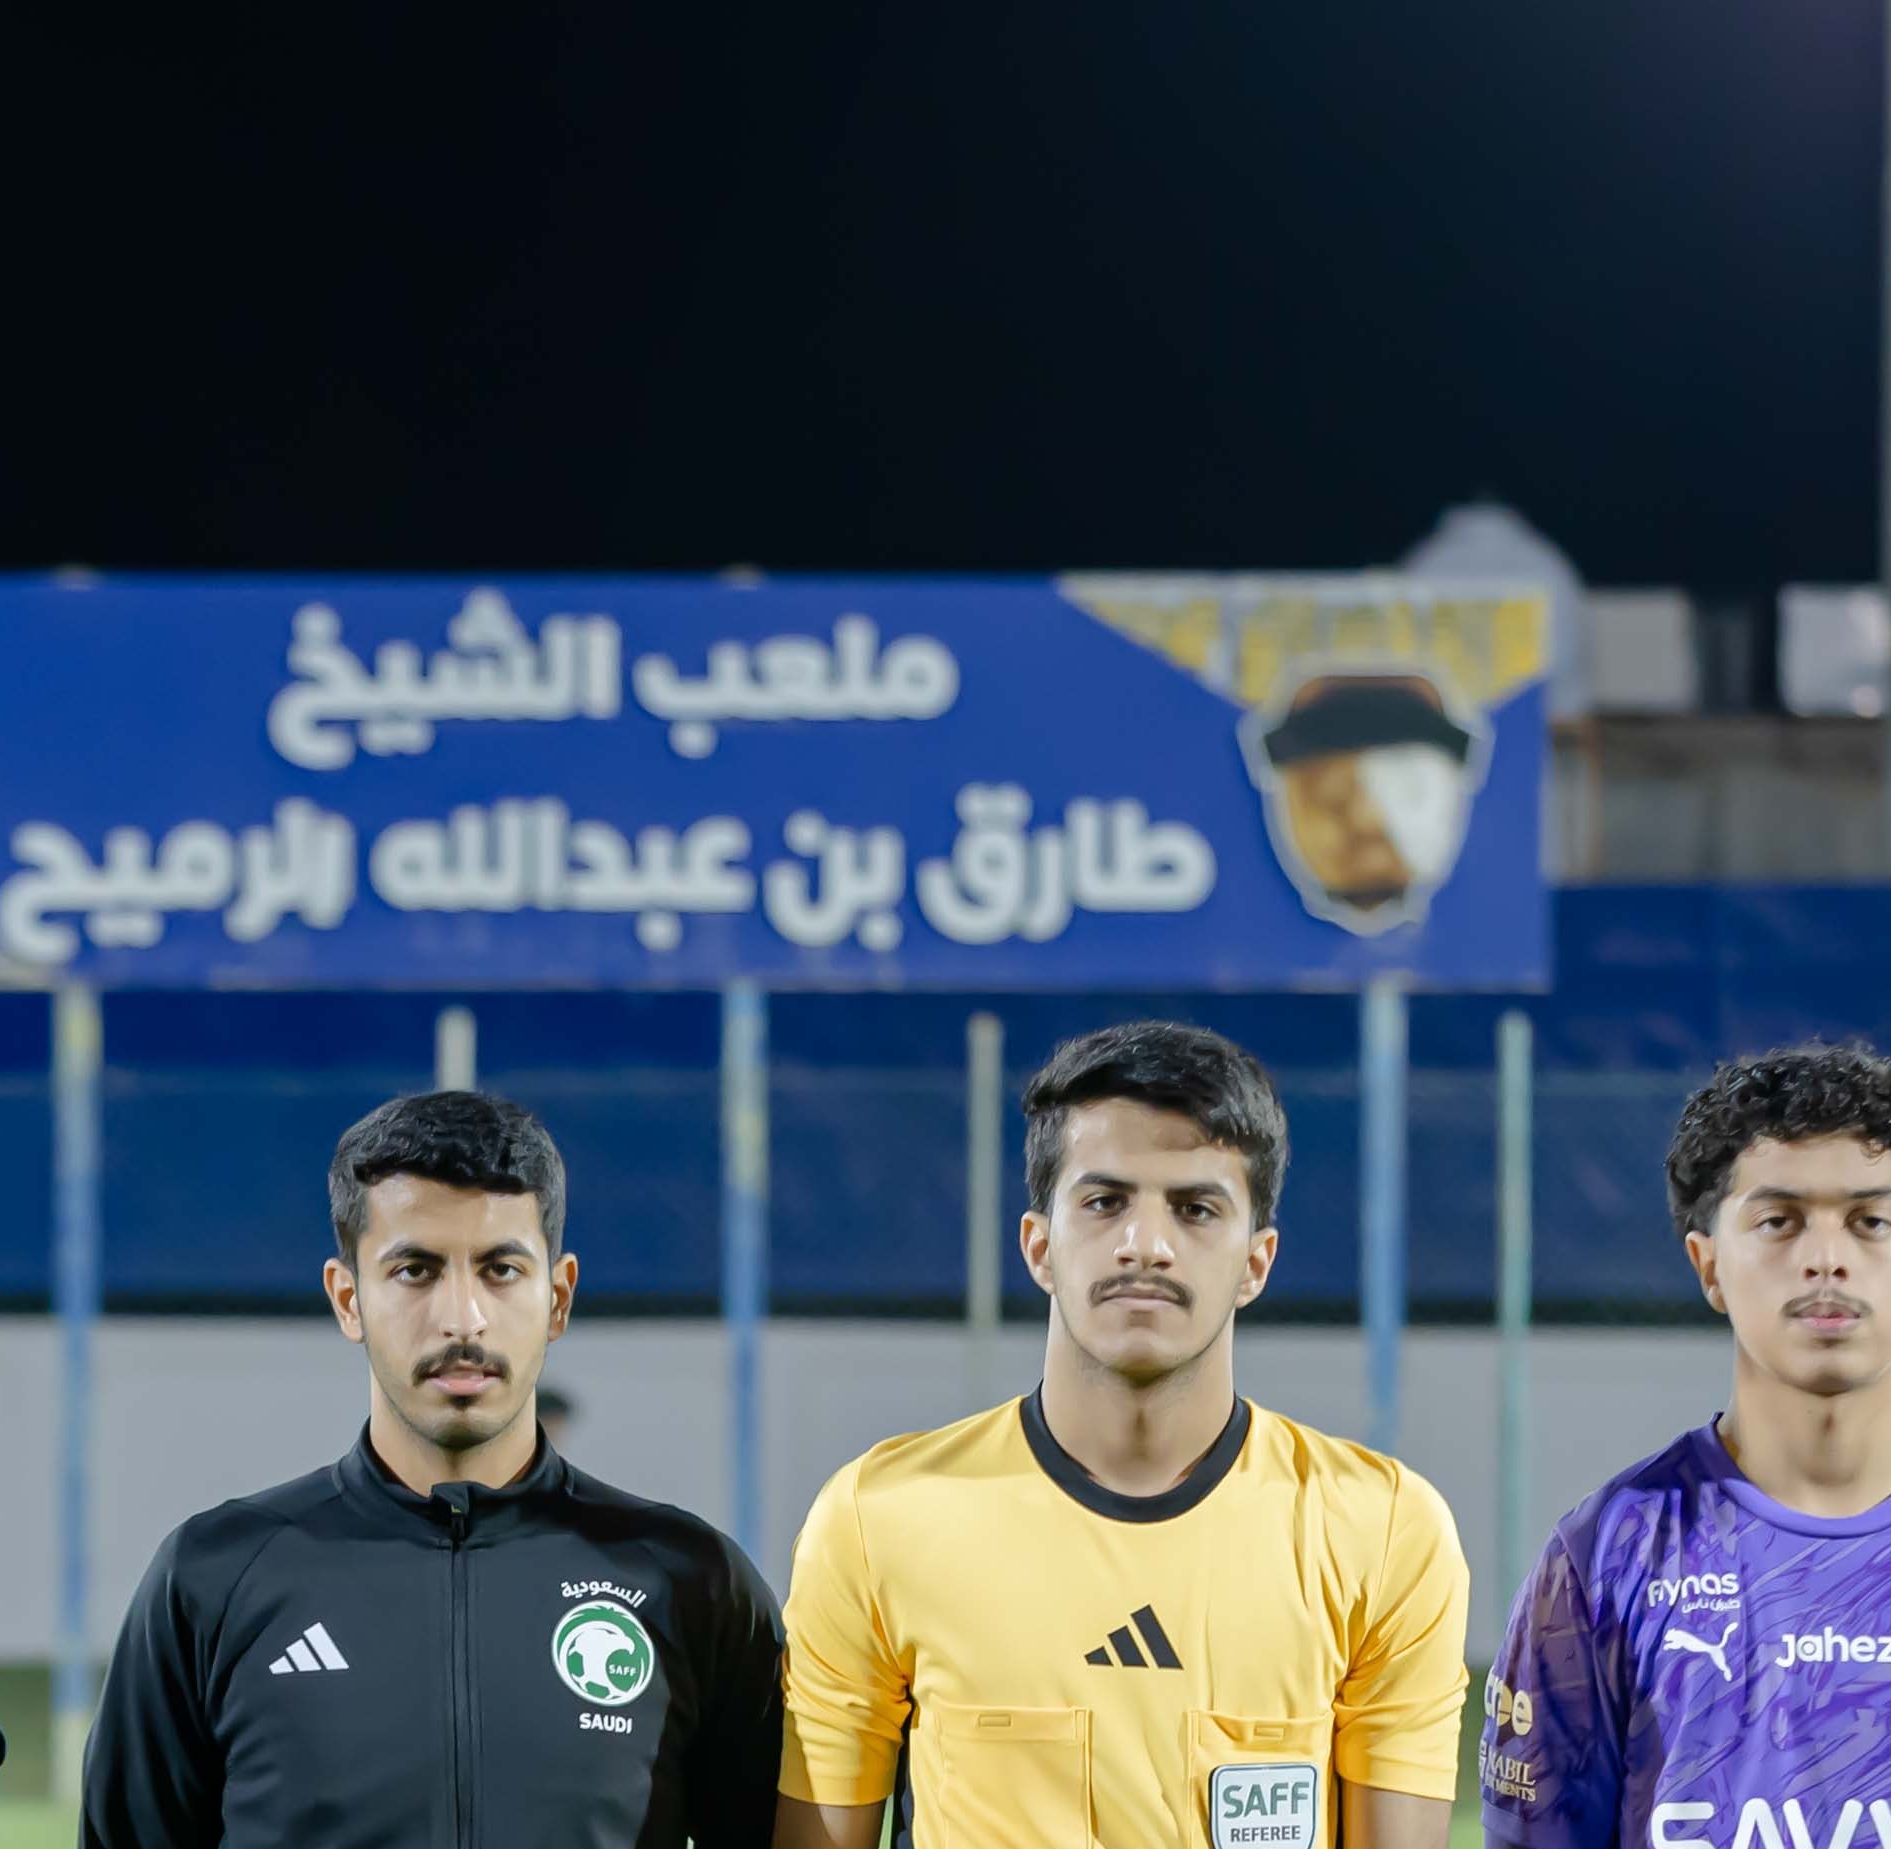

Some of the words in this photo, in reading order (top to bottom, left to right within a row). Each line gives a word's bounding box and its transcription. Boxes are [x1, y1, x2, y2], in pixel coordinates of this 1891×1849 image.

[267, 587, 621, 770] الشيخ
[634, 613, 958, 758] ملعب
[371, 797, 756, 952] عبدالله
[764, 810, 904, 952] بن
[916, 783, 1216, 945] طارق
[561, 1581, 647, 1608] السعودية
[608, 1664, 637, 1677] SAFF
[579, 1712, 633, 1734] SAUDI
[1222, 1781, 1310, 1818] SAFF
[1230, 1825, 1301, 1842] REFEREE
